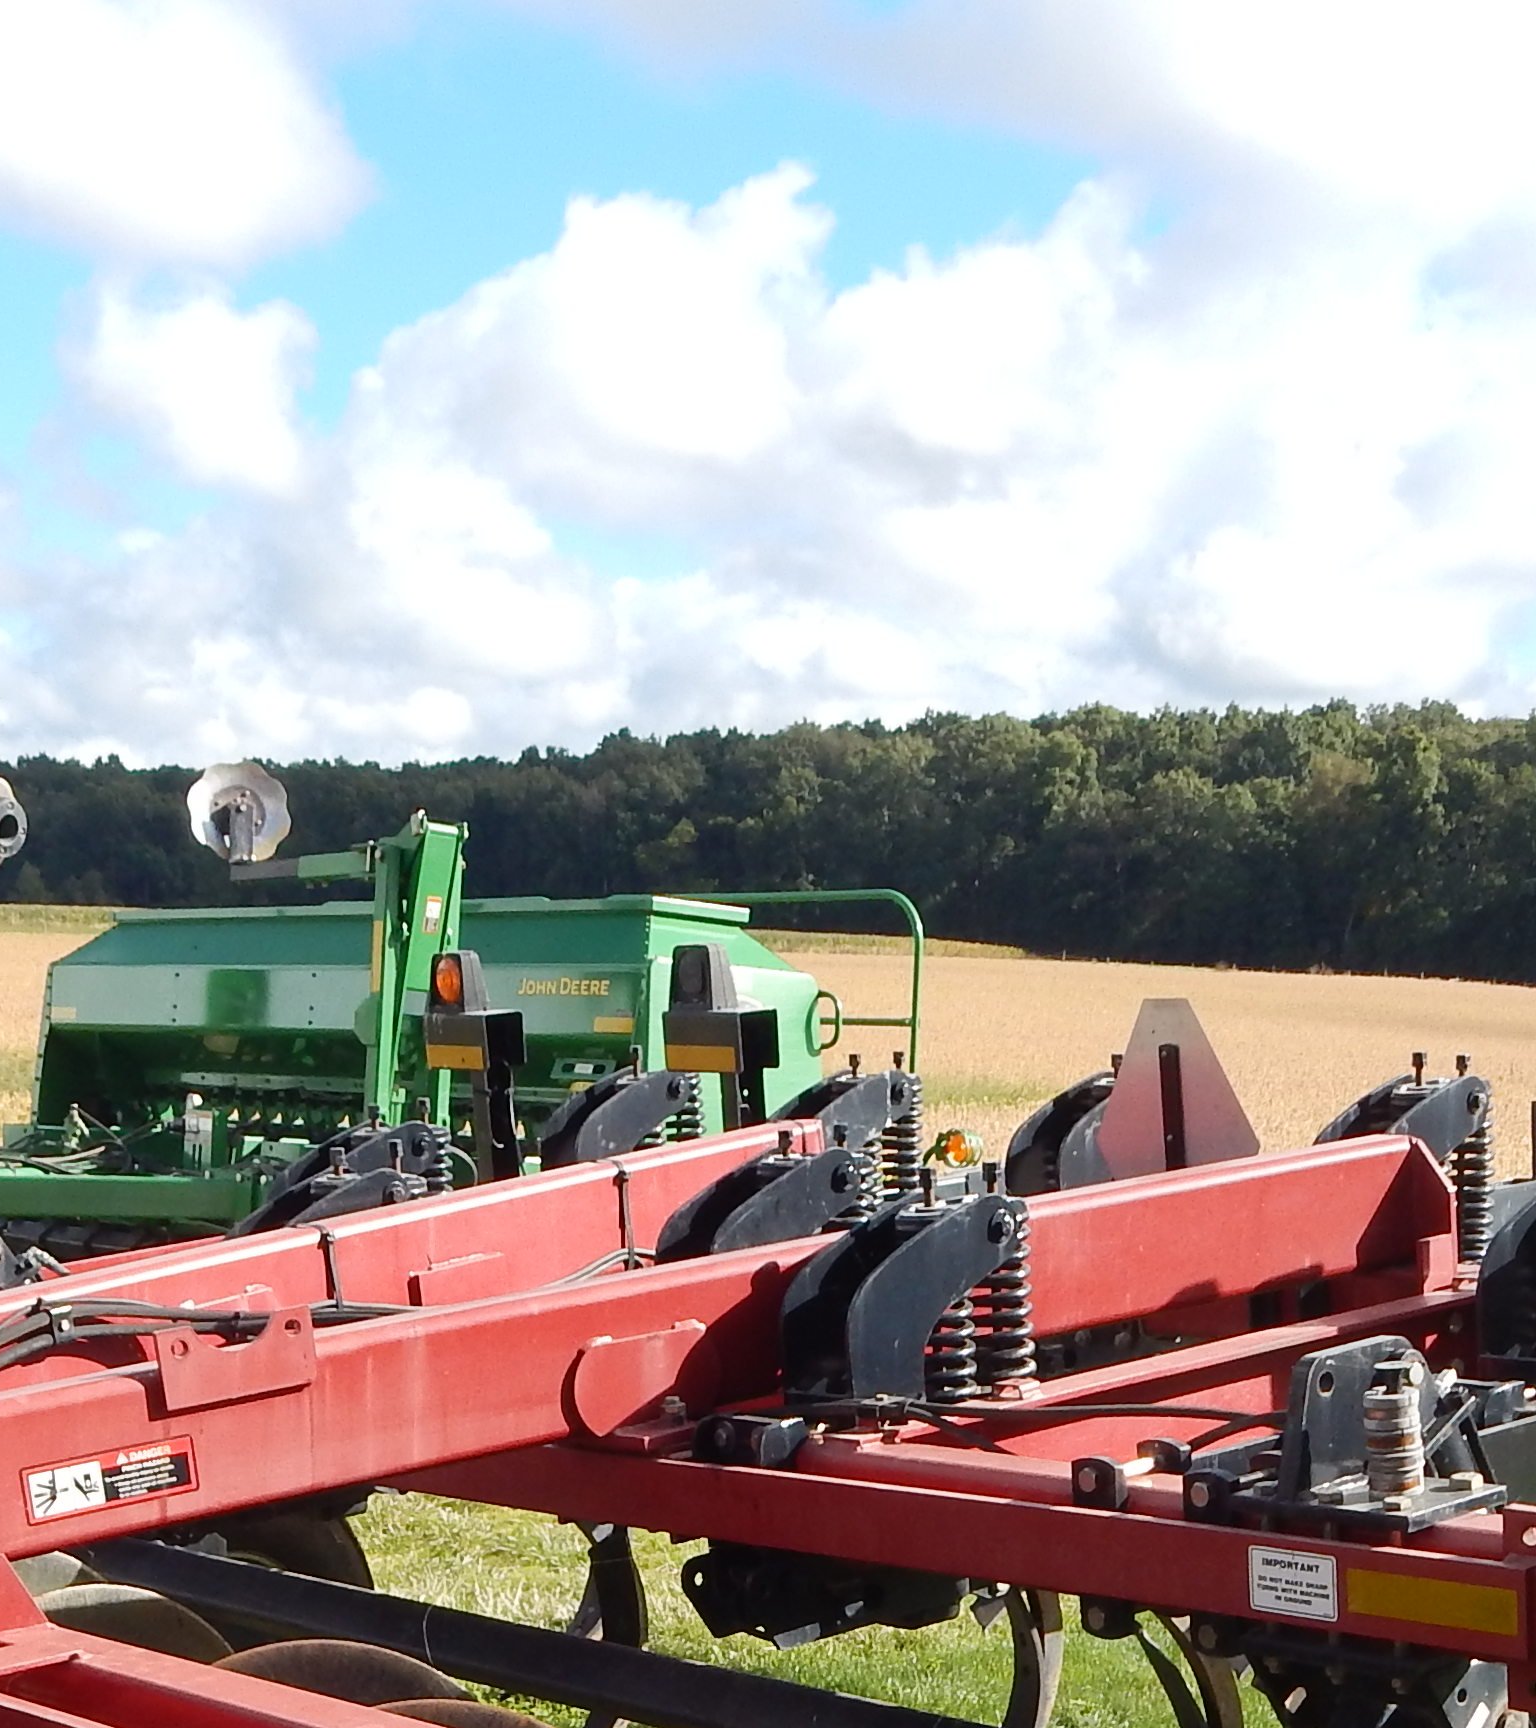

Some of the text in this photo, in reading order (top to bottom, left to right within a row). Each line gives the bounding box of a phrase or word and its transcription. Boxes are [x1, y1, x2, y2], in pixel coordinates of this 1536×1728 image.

[517, 977, 611, 996] JOHN DEERE
[128, 1445, 171, 1462] DANGER
[1262, 1558, 1320, 1573] IMPORTANT
